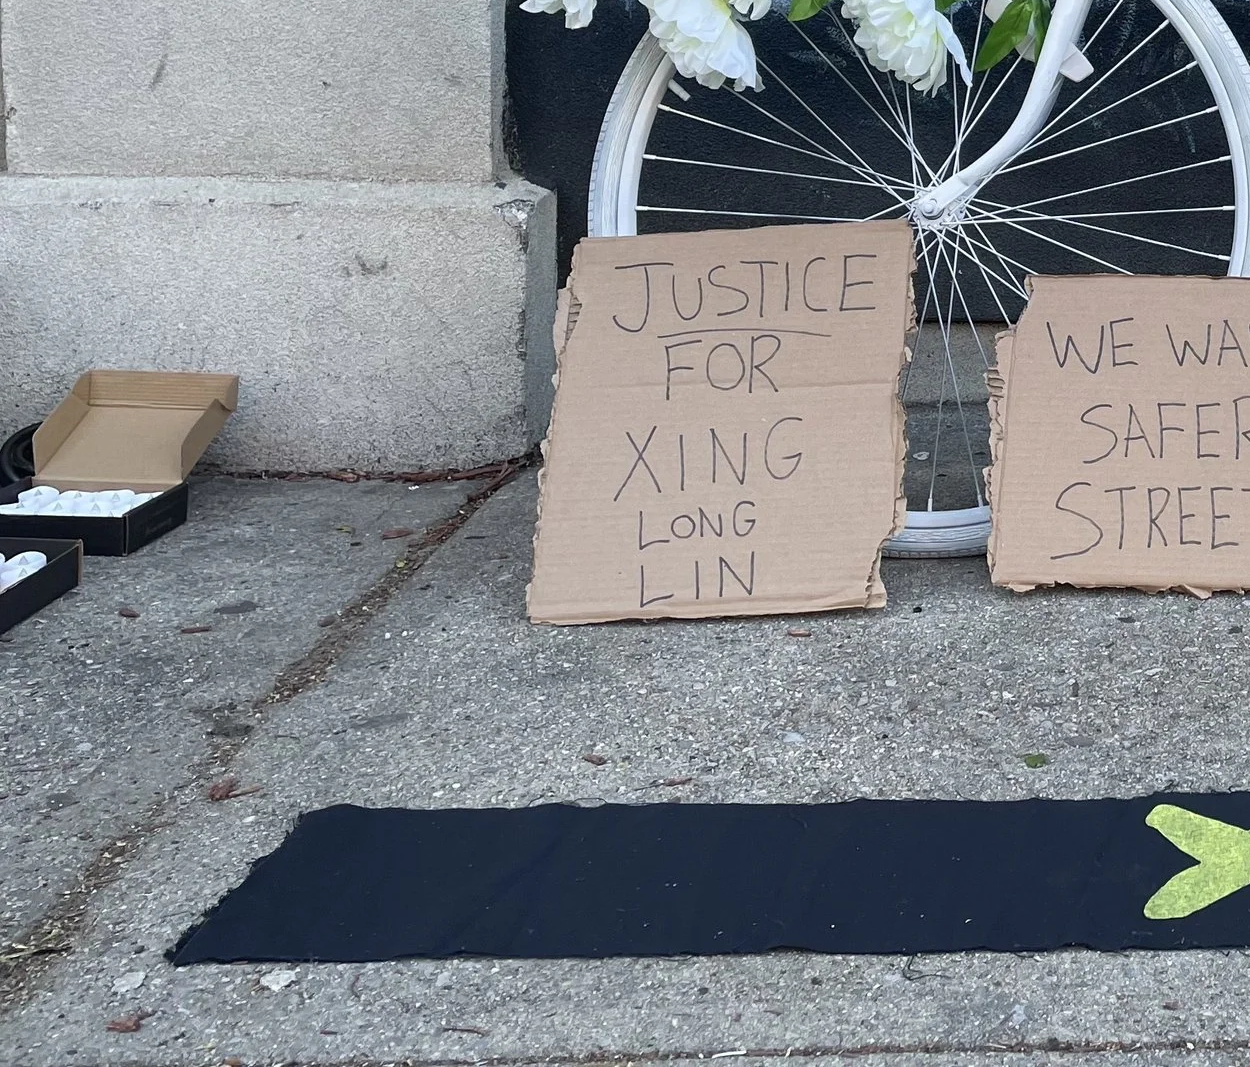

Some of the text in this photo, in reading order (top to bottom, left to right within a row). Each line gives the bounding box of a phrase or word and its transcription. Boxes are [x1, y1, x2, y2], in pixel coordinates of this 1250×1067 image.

[613, 255, 877, 332] JUSTICE
[664, 334, 781, 401] FOR
[1046, 317, 1139, 374] WE
[613, 417, 804, 502] XING
[638, 500, 757, 551] LONG
[639, 551, 756, 608] LIN
